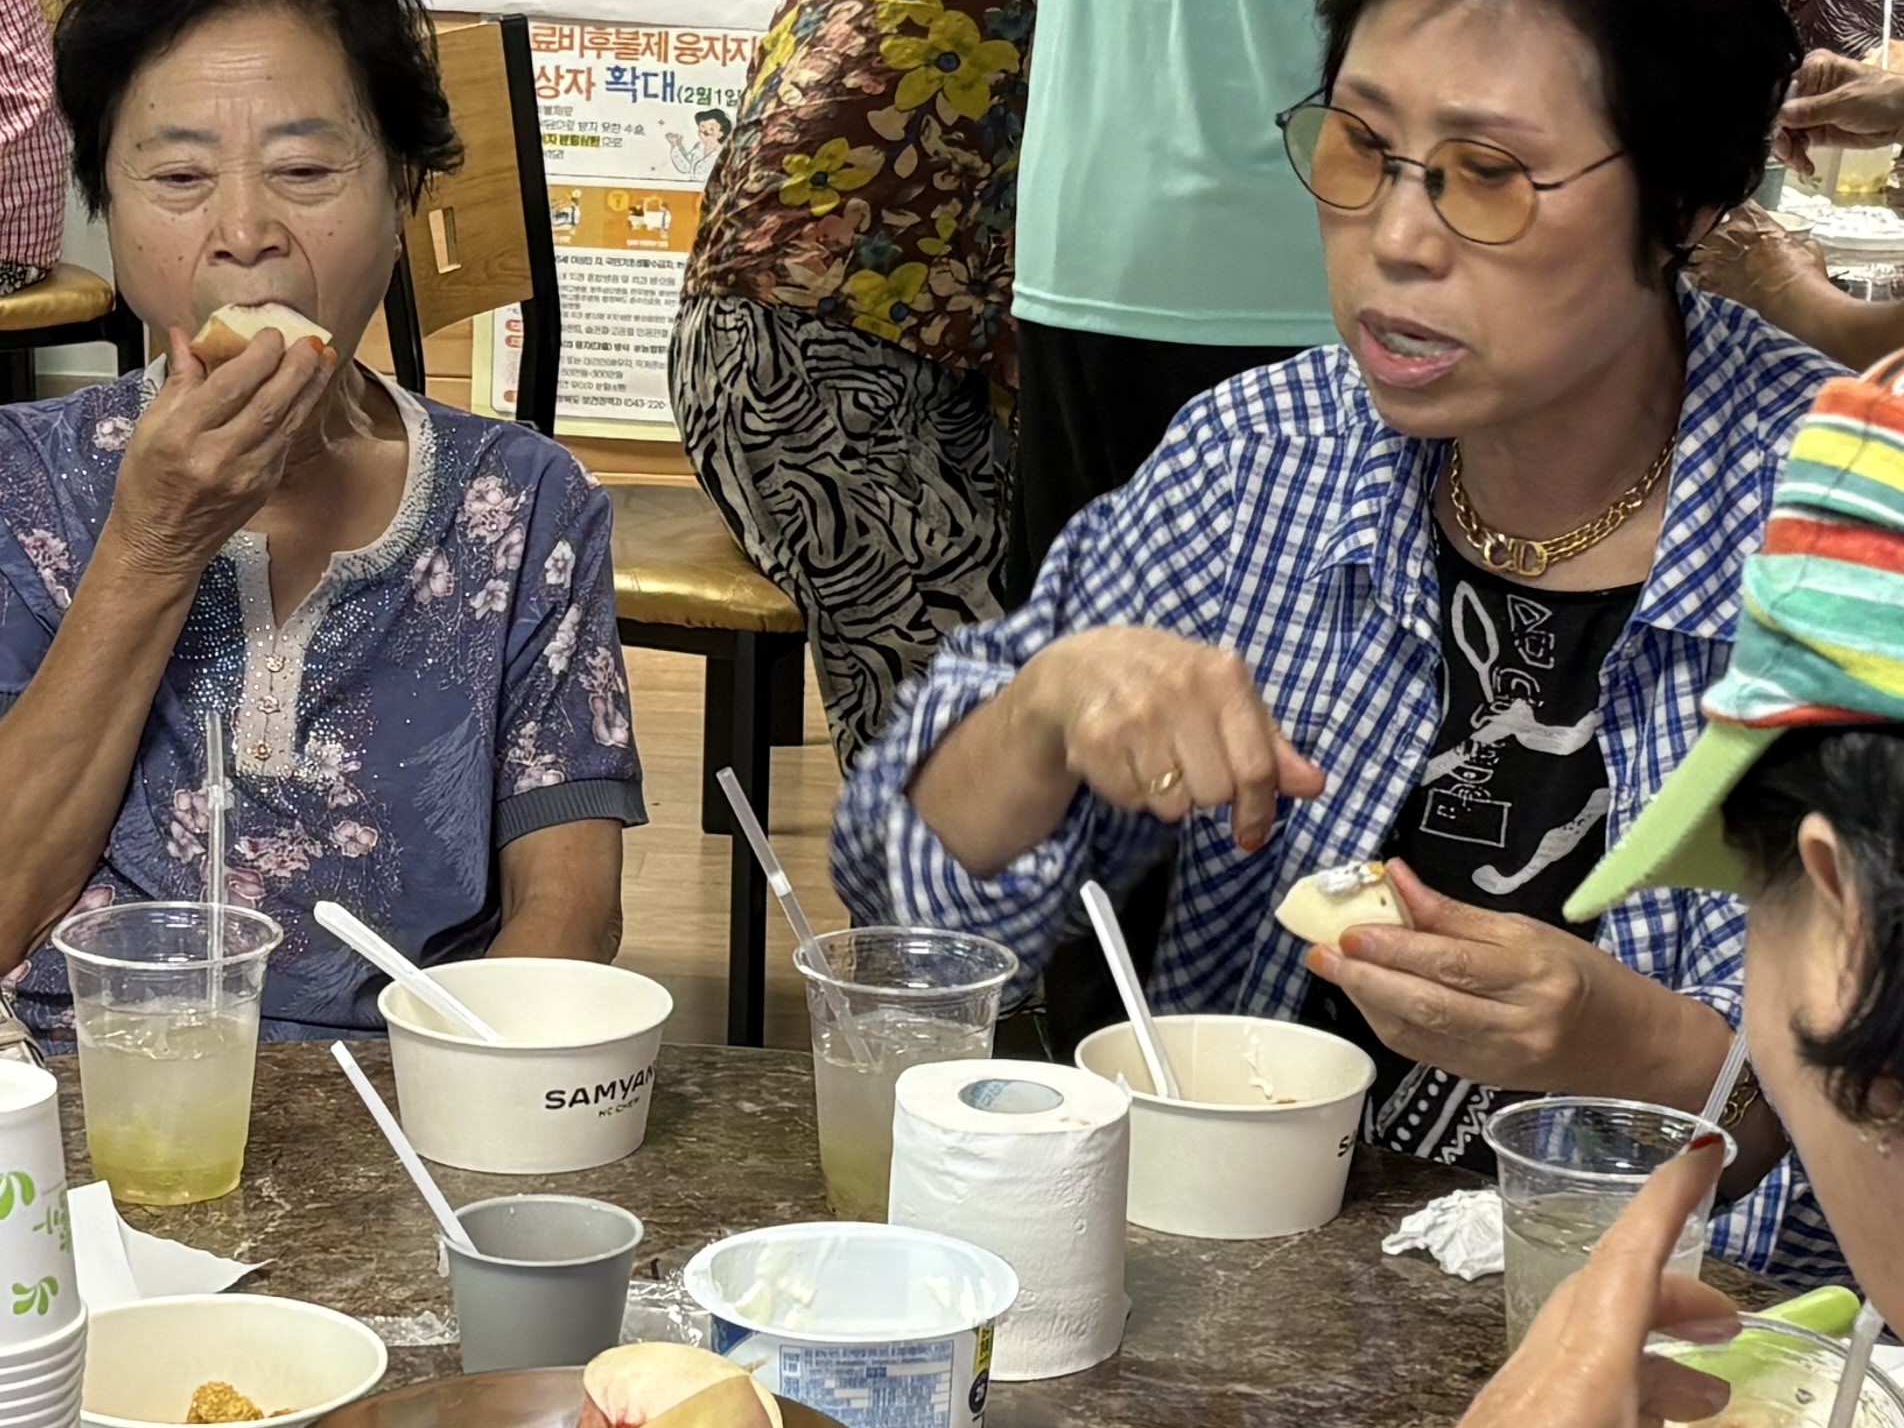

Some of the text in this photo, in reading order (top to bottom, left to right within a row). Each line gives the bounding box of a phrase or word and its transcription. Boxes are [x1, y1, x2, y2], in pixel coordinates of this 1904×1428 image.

[532, 25, 760, 68] 료비후불제 융자지
[536, 65, 596, 102] 상자
[605, 65, 676, 104] 확대
[544, 1065, 656, 1110] SAMYAN
